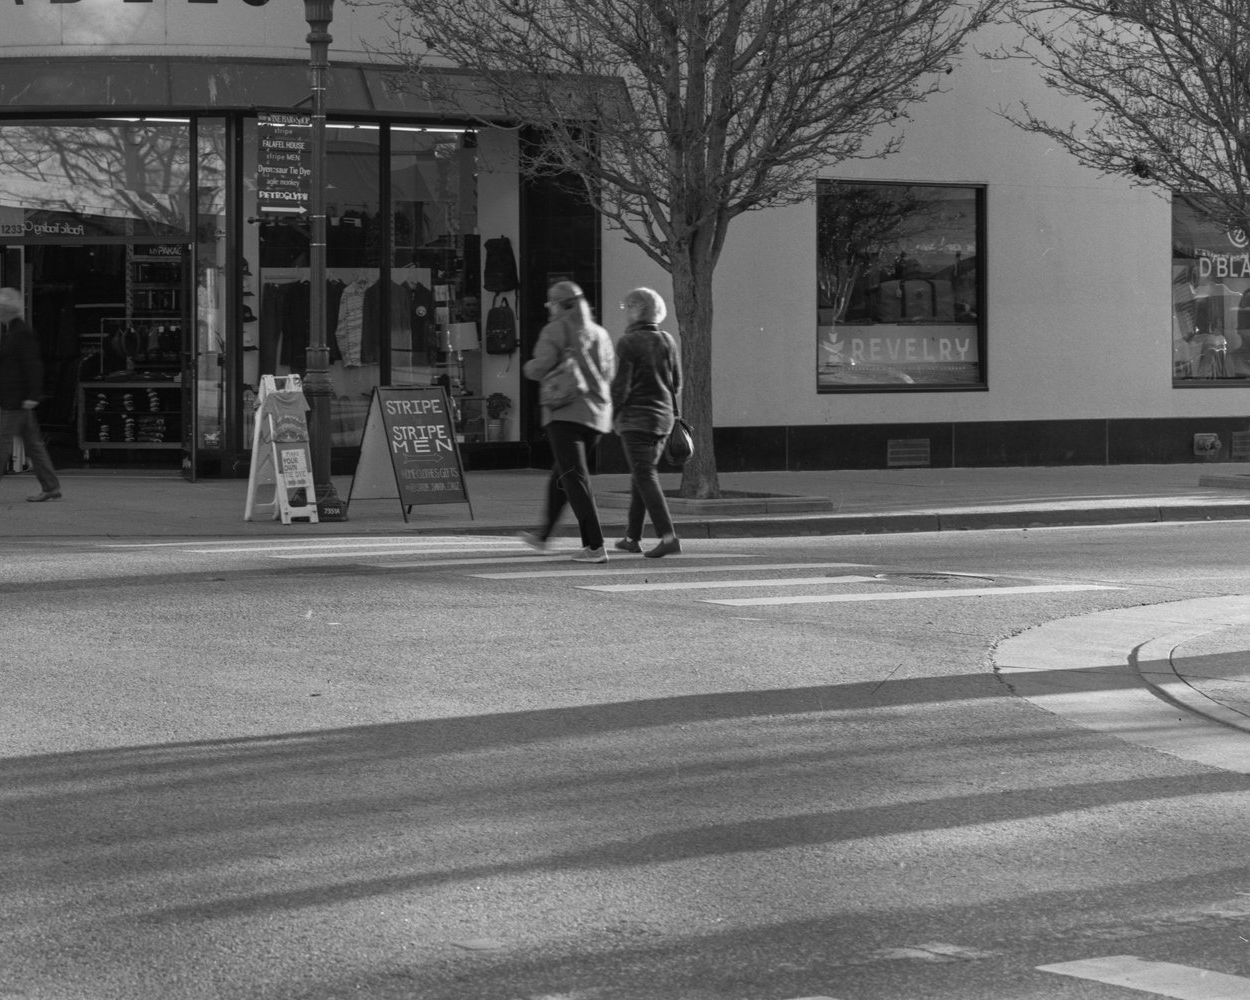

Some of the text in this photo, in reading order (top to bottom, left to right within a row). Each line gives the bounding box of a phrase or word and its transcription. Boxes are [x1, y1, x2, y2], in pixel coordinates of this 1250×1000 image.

[262, 140, 285, 148] FALAFEL
[289, 166, 299, 174] Tie
[299, 167, 311, 176] Dye
[280, 179, 300, 188] monkey
[259, 191, 308, 200] PETROGLYPH
[1, 225, 22, 234] 1233
[851, 338, 969, 361] REVELRY
[386, 399, 443, 415] STRIPE
[392, 425, 447, 441] STRIPE
[392, 438, 453, 453] MEN
